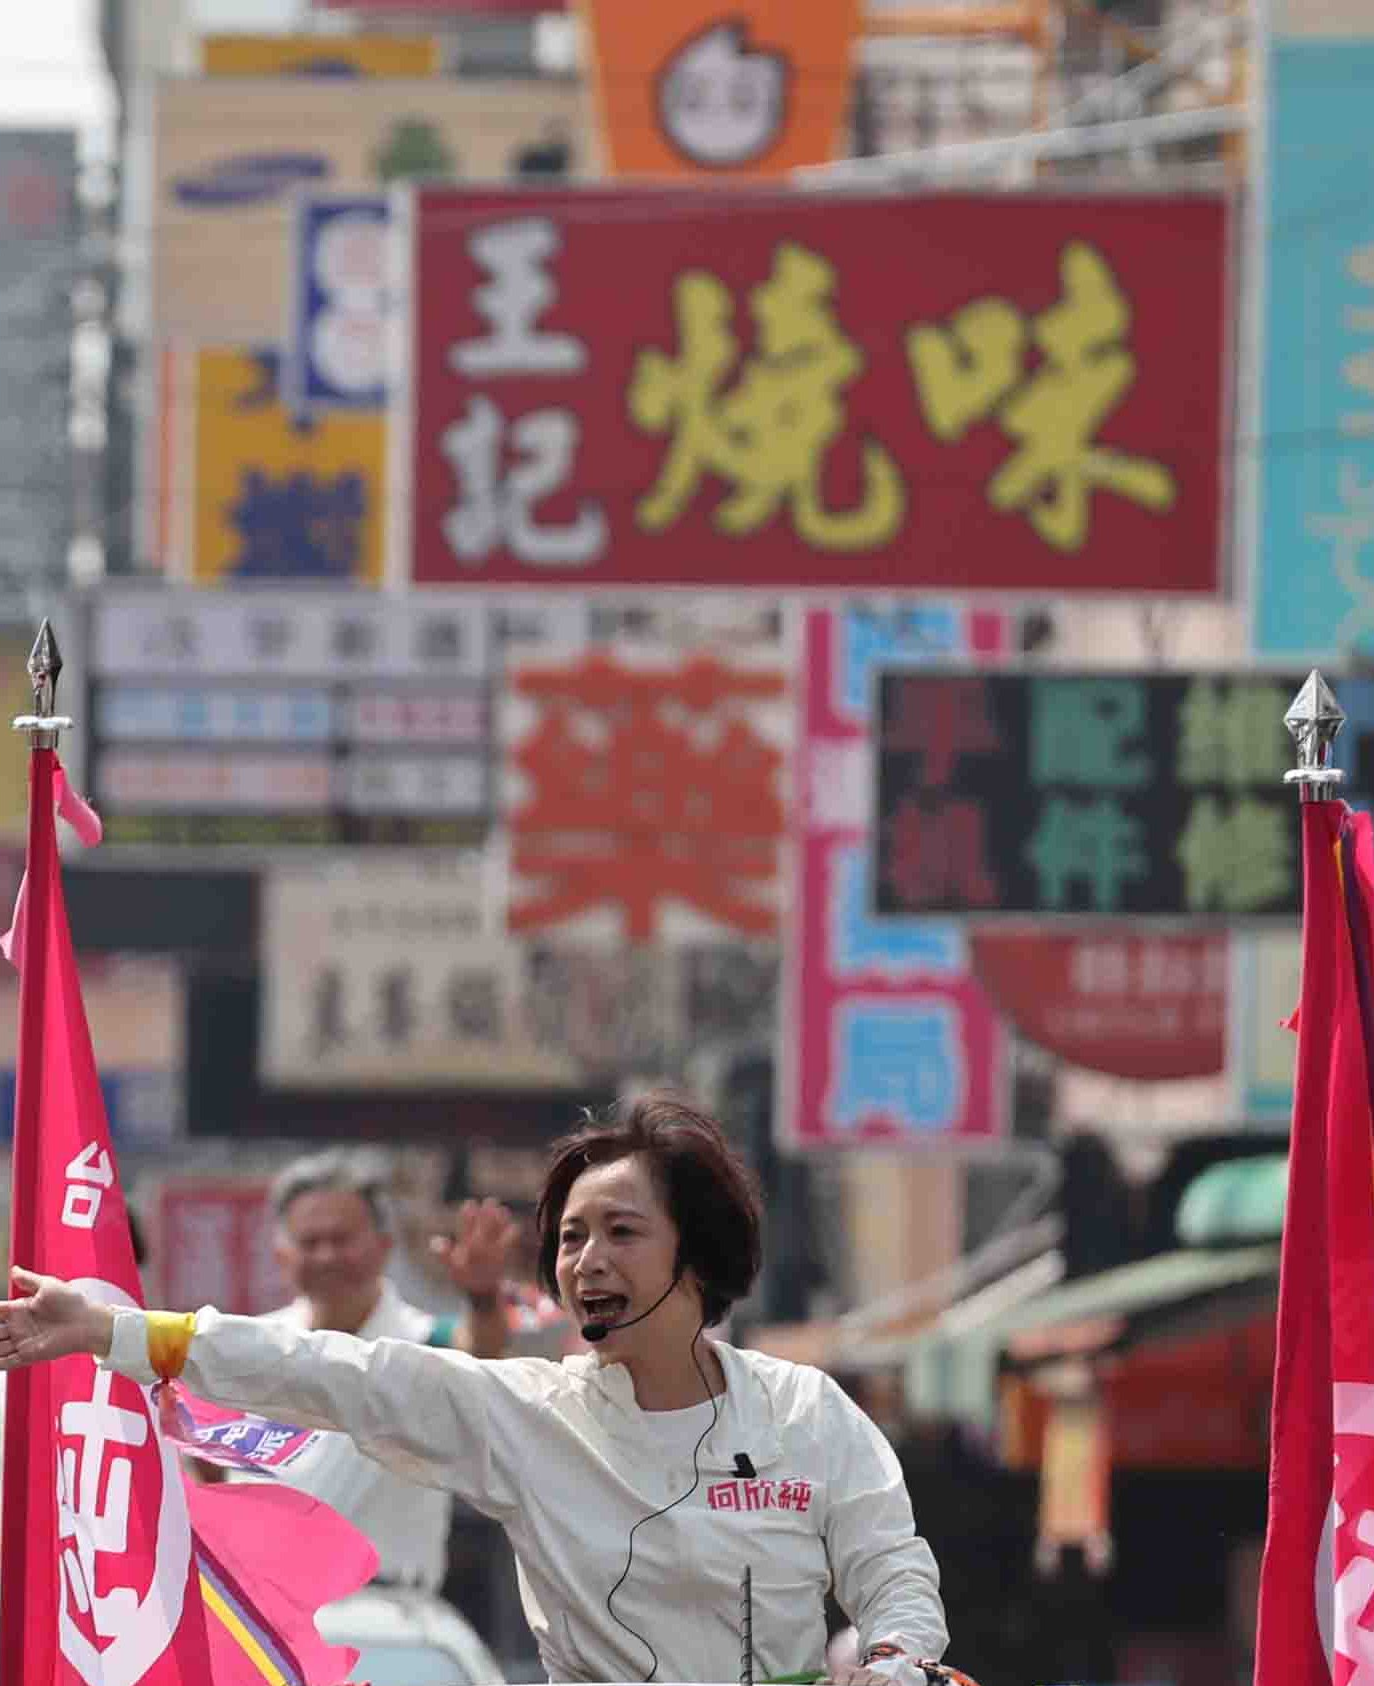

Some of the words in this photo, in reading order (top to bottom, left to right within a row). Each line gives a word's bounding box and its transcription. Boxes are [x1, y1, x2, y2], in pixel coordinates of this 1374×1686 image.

[442, 215, 607, 565] 王記
[627, 240, 1175, 552] 燒味
[706, 1478, 813, 1513] 何欣純
